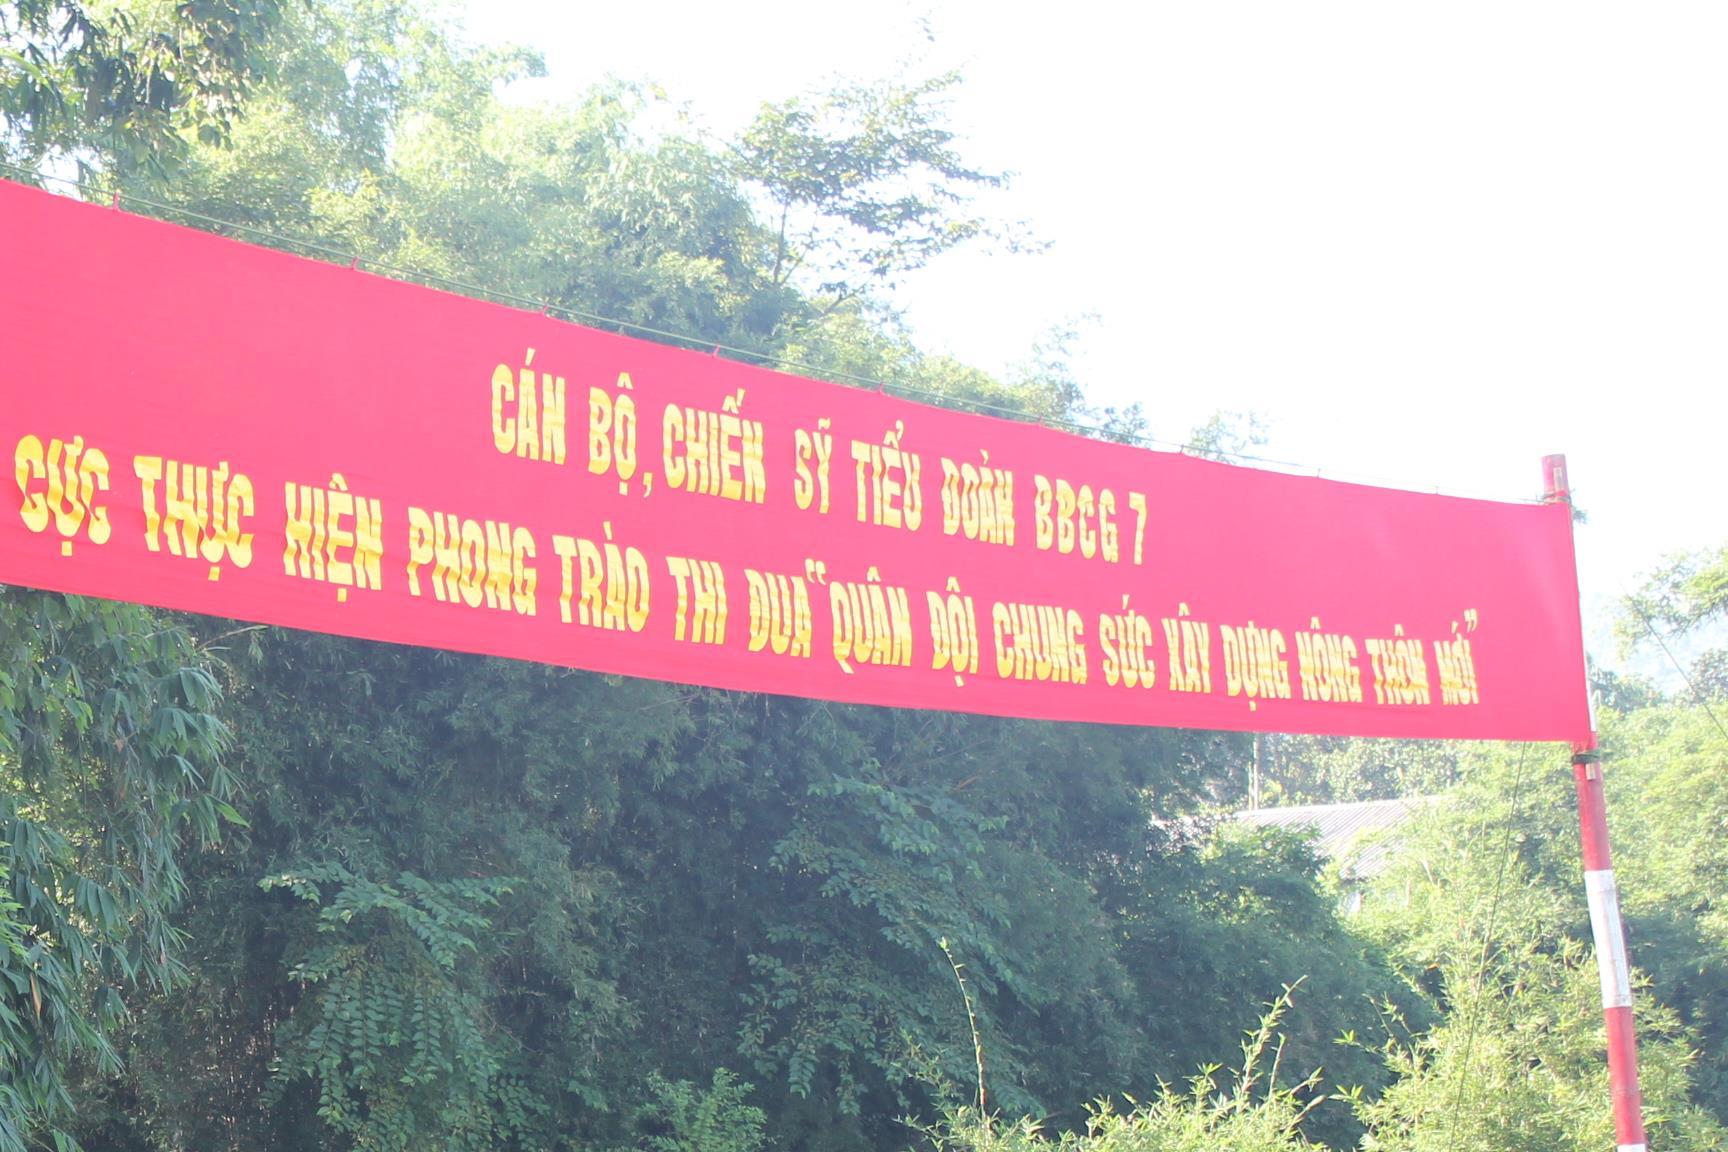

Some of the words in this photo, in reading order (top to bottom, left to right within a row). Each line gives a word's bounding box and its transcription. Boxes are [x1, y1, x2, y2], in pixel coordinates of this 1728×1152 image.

[14, 434, 112, 556] CỰC
[133, 455, 255, 581] THỰC
[282, 473, 383, 602] HIỆN
[406, 506, 538, 616] PHONG
[552, 521, 651, 632] TRÀO
[666, 556, 729, 645] THI
[926, 576, 979, 688] ĐỘI
[992, 601, 1088, 685] CHUNG
[1099, 594, 1156, 689] SỨC
[1161, 602, 1212, 693] XÂY
[1220, 620, 1291, 711] DỰNG
[1295, 616, 1364, 704] NÔNG
[1365, 624, 1431, 705] THÔN
[490, 347, 566, 465] CÁN
[662, 388, 766, 504] CHIẾN
[794, 418, 832, 514] SỸ
[851, 420, 922, 531] TIỂU
[940, 449, 1015, 546] ĐOÀN
[1033, 475, 1119, 564] BBCG
[1129, 492, 1147, 565] 7
